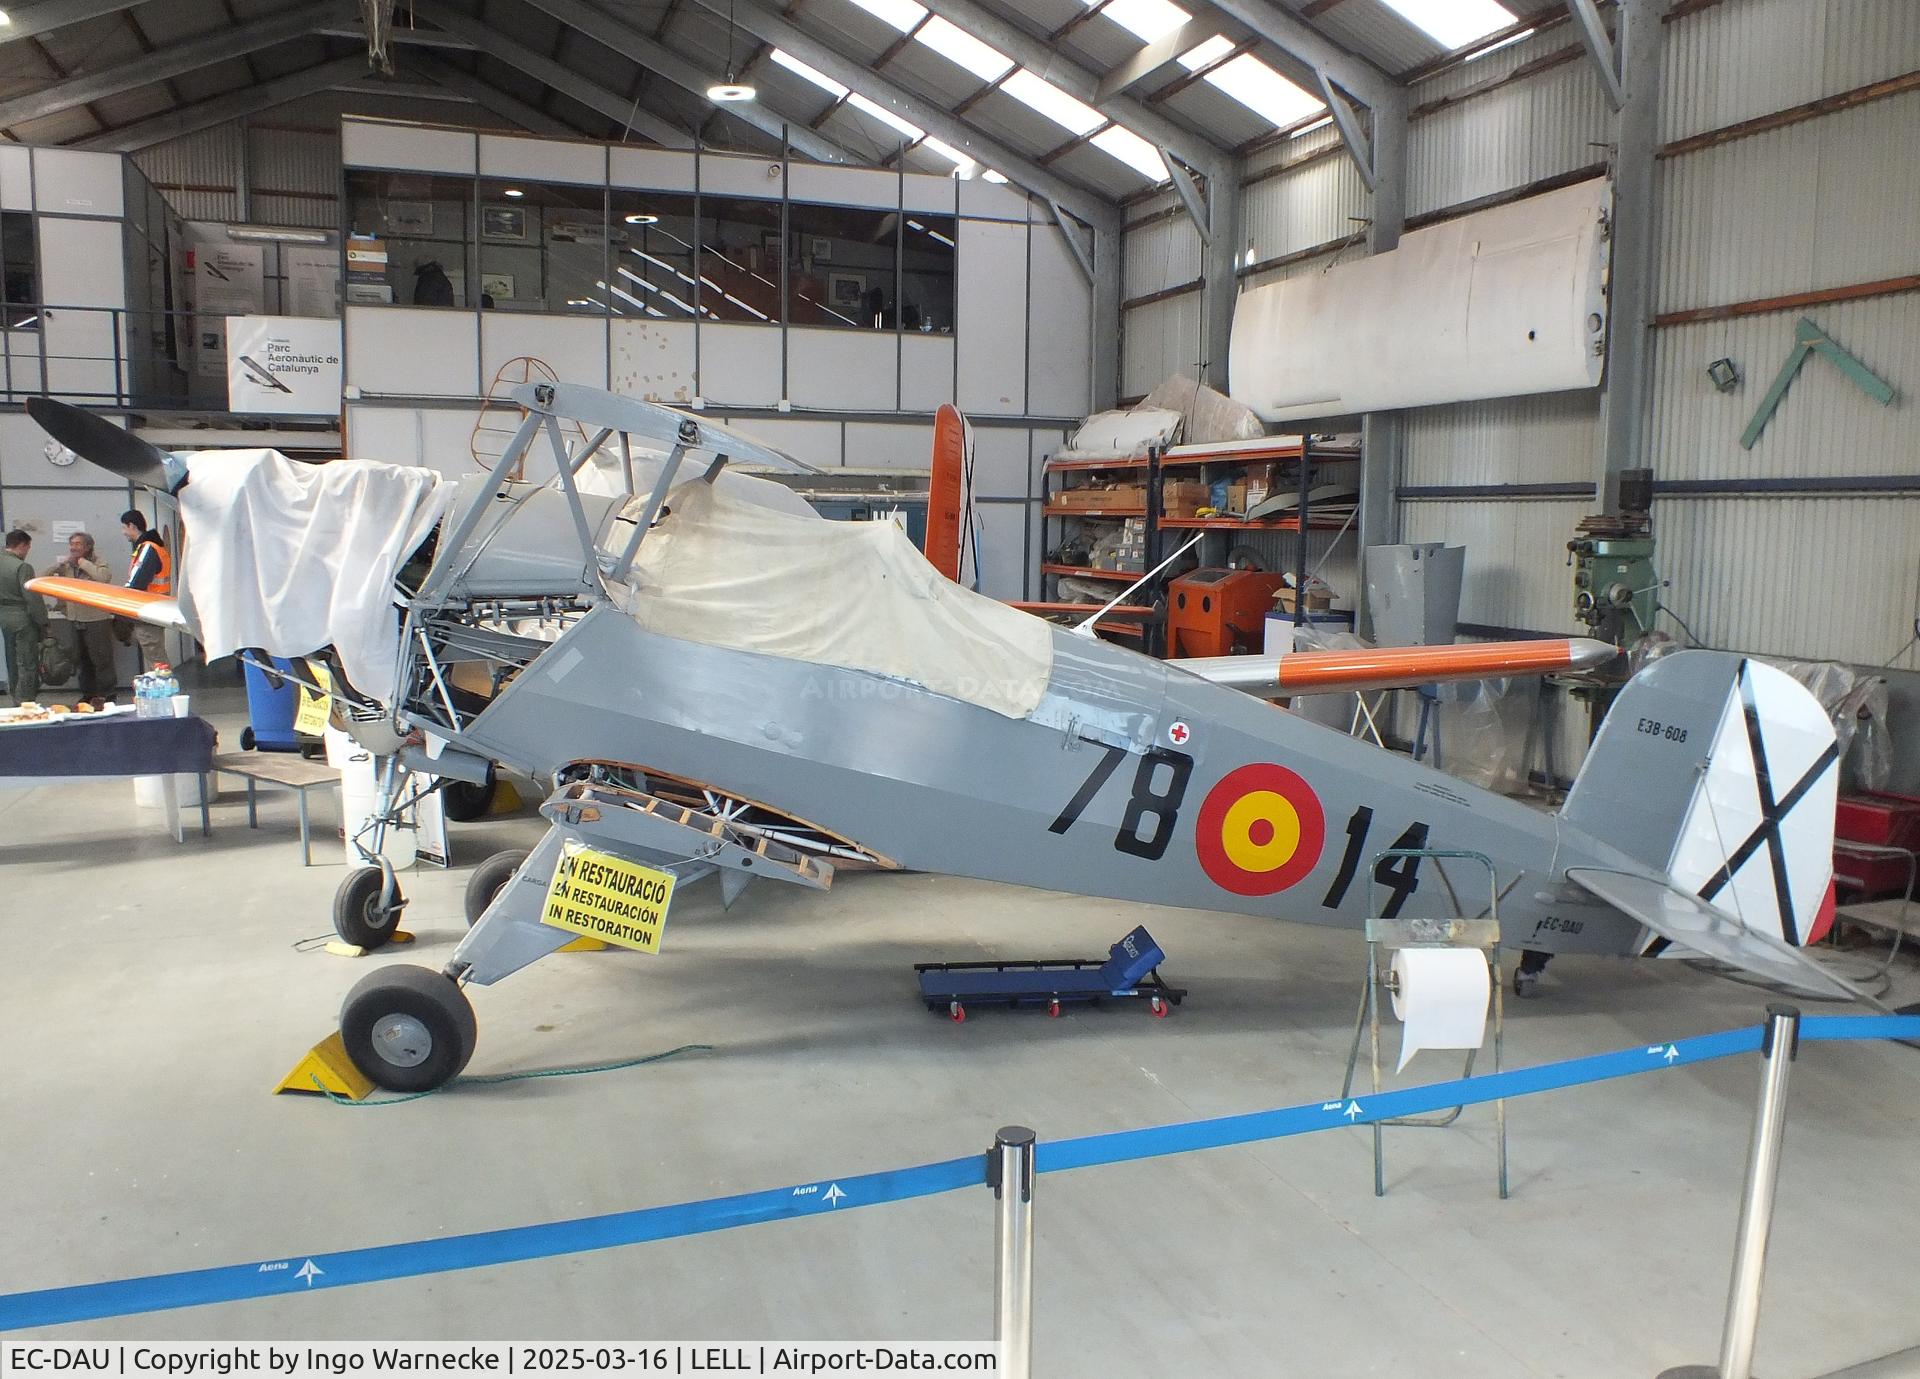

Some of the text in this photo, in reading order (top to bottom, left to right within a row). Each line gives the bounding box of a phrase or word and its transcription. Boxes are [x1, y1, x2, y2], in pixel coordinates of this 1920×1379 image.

[267, 343, 291, 353] Parc
[268, 353, 339, 364] Aeronàutic de
[268, 363, 319, 375] Catalunya
[1637, 718, 1688, 743] E3B-608
[1048, 735, 1431, 919] 78 14
[578, 860, 666, 904] RESTAURACIÓ
[571, 888, 659, 925] RESTAURACIÓN
[549, 904, 652, 945] IN RESTORATION
[792, 1185, 818, 1196] Aena
[258, 1262, 289, 1273] Aena
